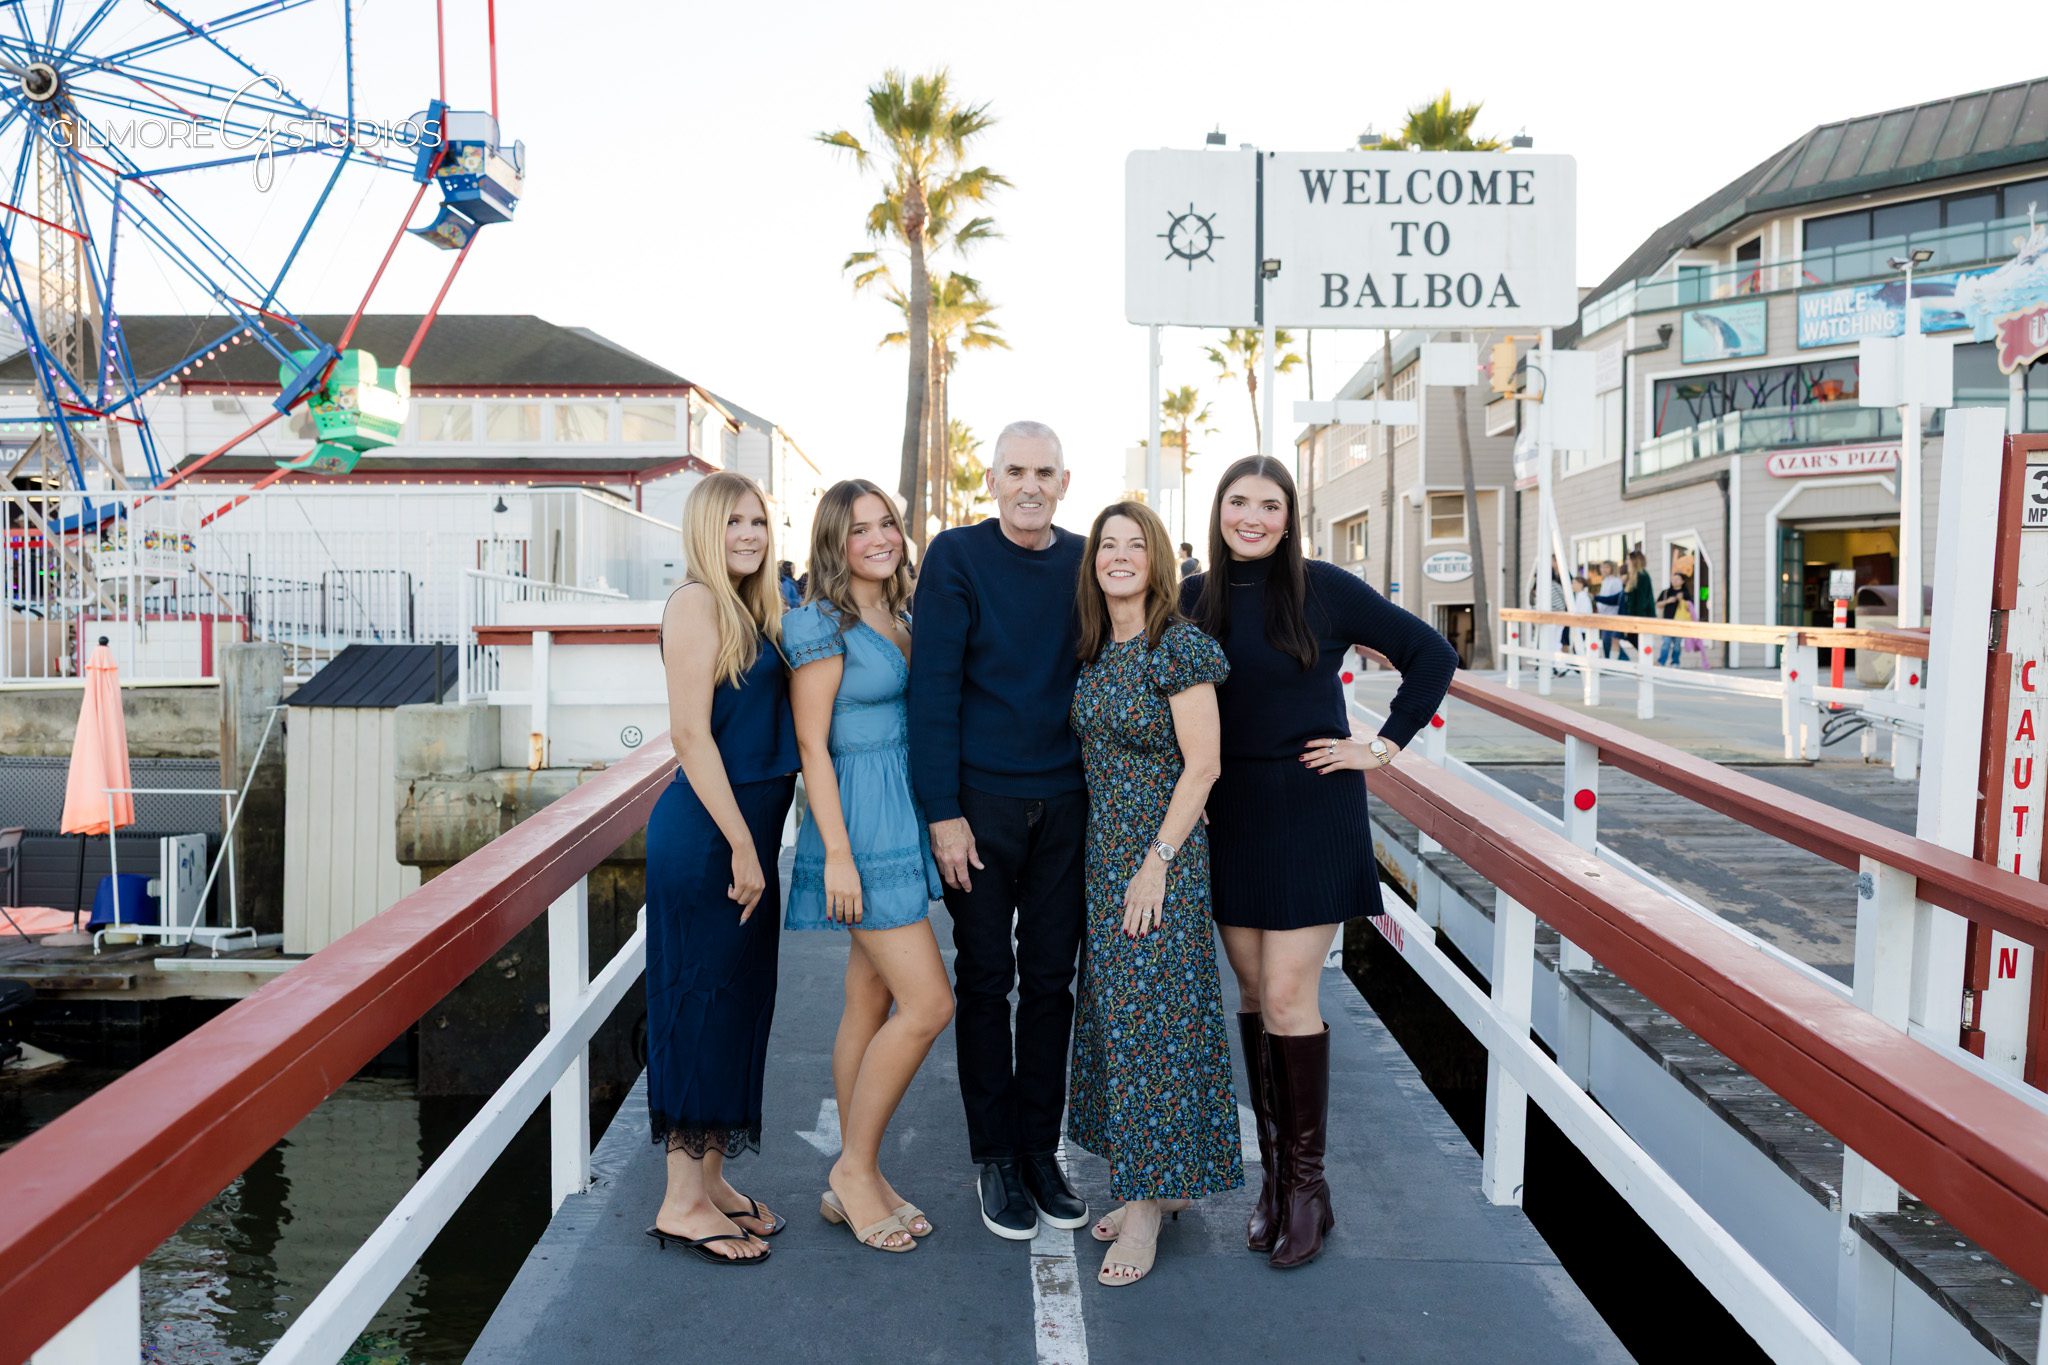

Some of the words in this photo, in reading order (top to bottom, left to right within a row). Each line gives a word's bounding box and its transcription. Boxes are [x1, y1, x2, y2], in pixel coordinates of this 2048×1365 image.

[1299, 169, 1535, 205] WELCOME
[1391, 221, 1450, 257] TO
[1319, 272, 1521, 308] BALBOA
[1804, 291, 1867, 318] WHALE
[1803, 310, 1896, 341] WATCHING
[1777, 453, 1838, 470] AZAR'S
[1998, 660, 2036, 979] CAUTIN
